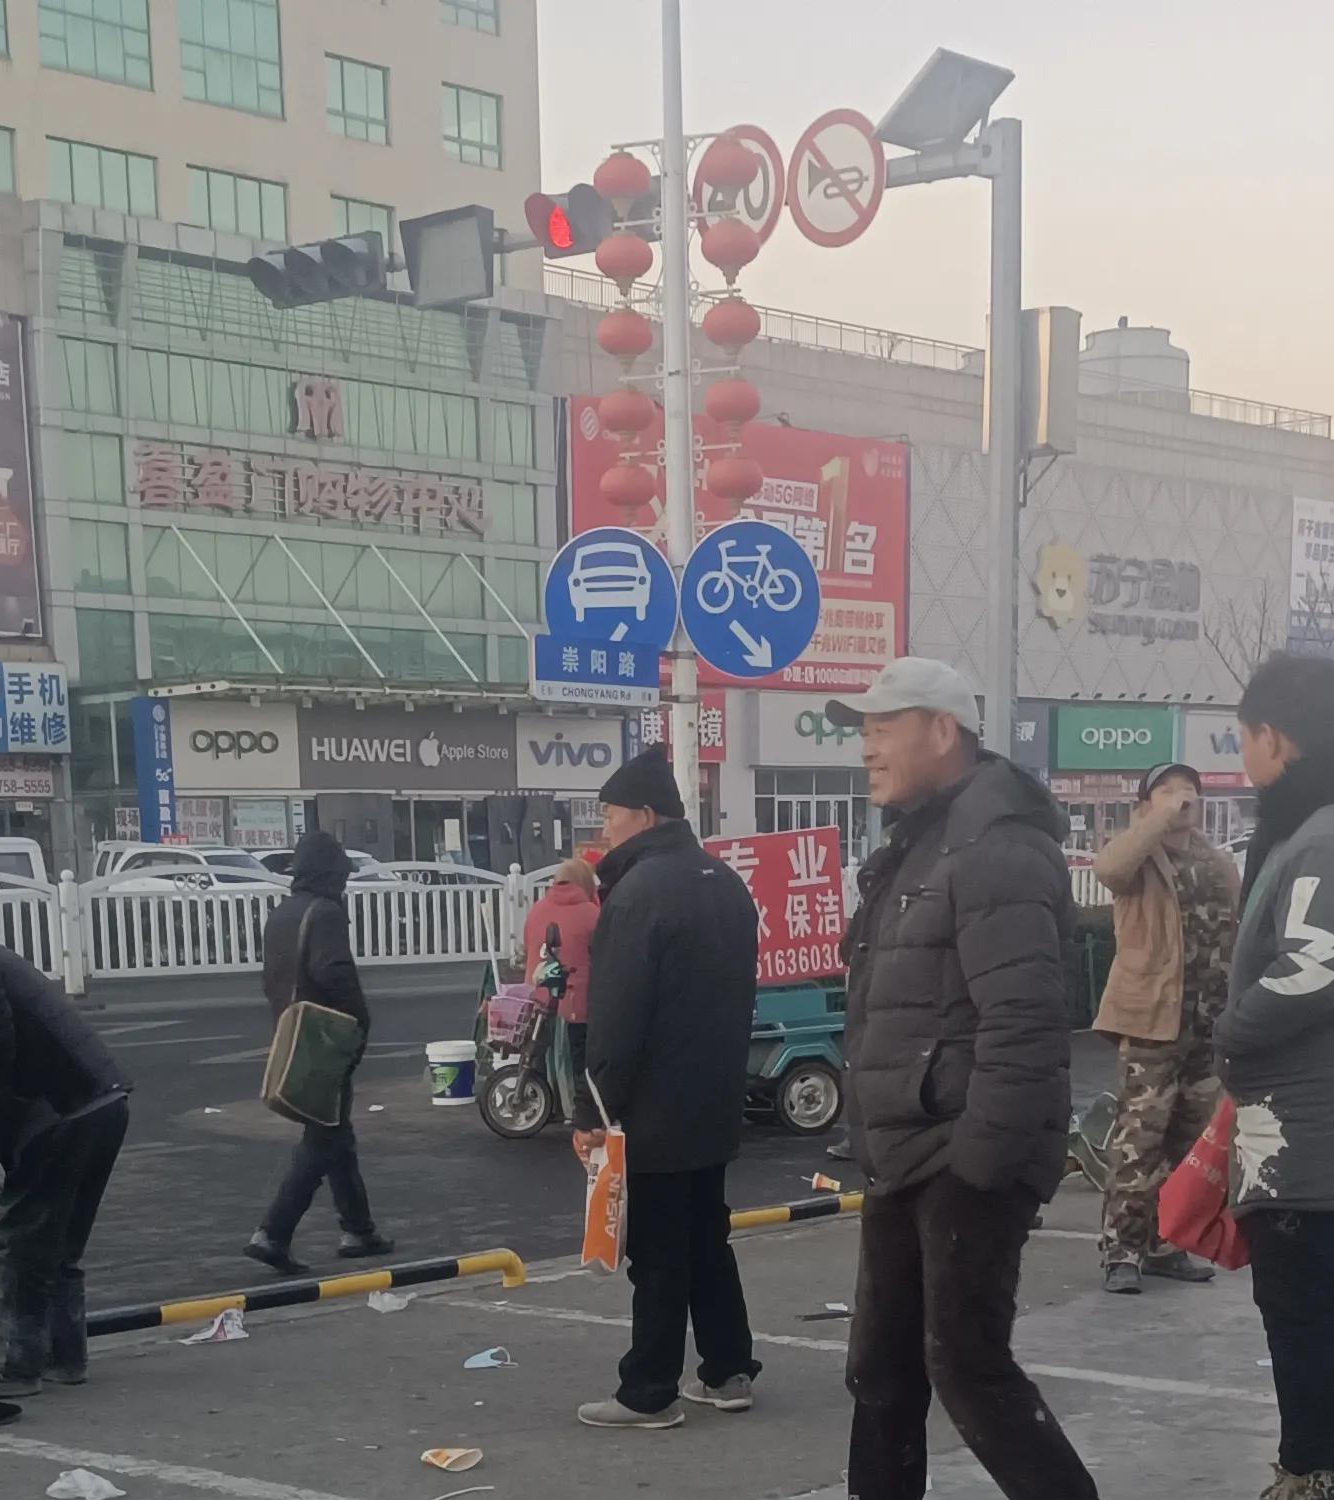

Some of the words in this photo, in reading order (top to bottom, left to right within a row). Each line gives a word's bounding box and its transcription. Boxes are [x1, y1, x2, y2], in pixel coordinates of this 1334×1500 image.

[562, 646, 636, 678] 崇阳路
[7, 672, 66, 707] 手机
[562, 686, 618, 700] CHONGYANG
[10, 712, 68, 746] 维修
[189, 730, 279, 760] oppo
[1081, 727, 1152, 750] oppo
[311, 737, 411, 762] HUAWEI
[441, 744, 475, 761] Apple
[478, 743, 509, 760] Store
[529, 732, 612, 768] vivo
[719, 835, 830, 892] 专业
[785, 889, 841, 939] 保洁
